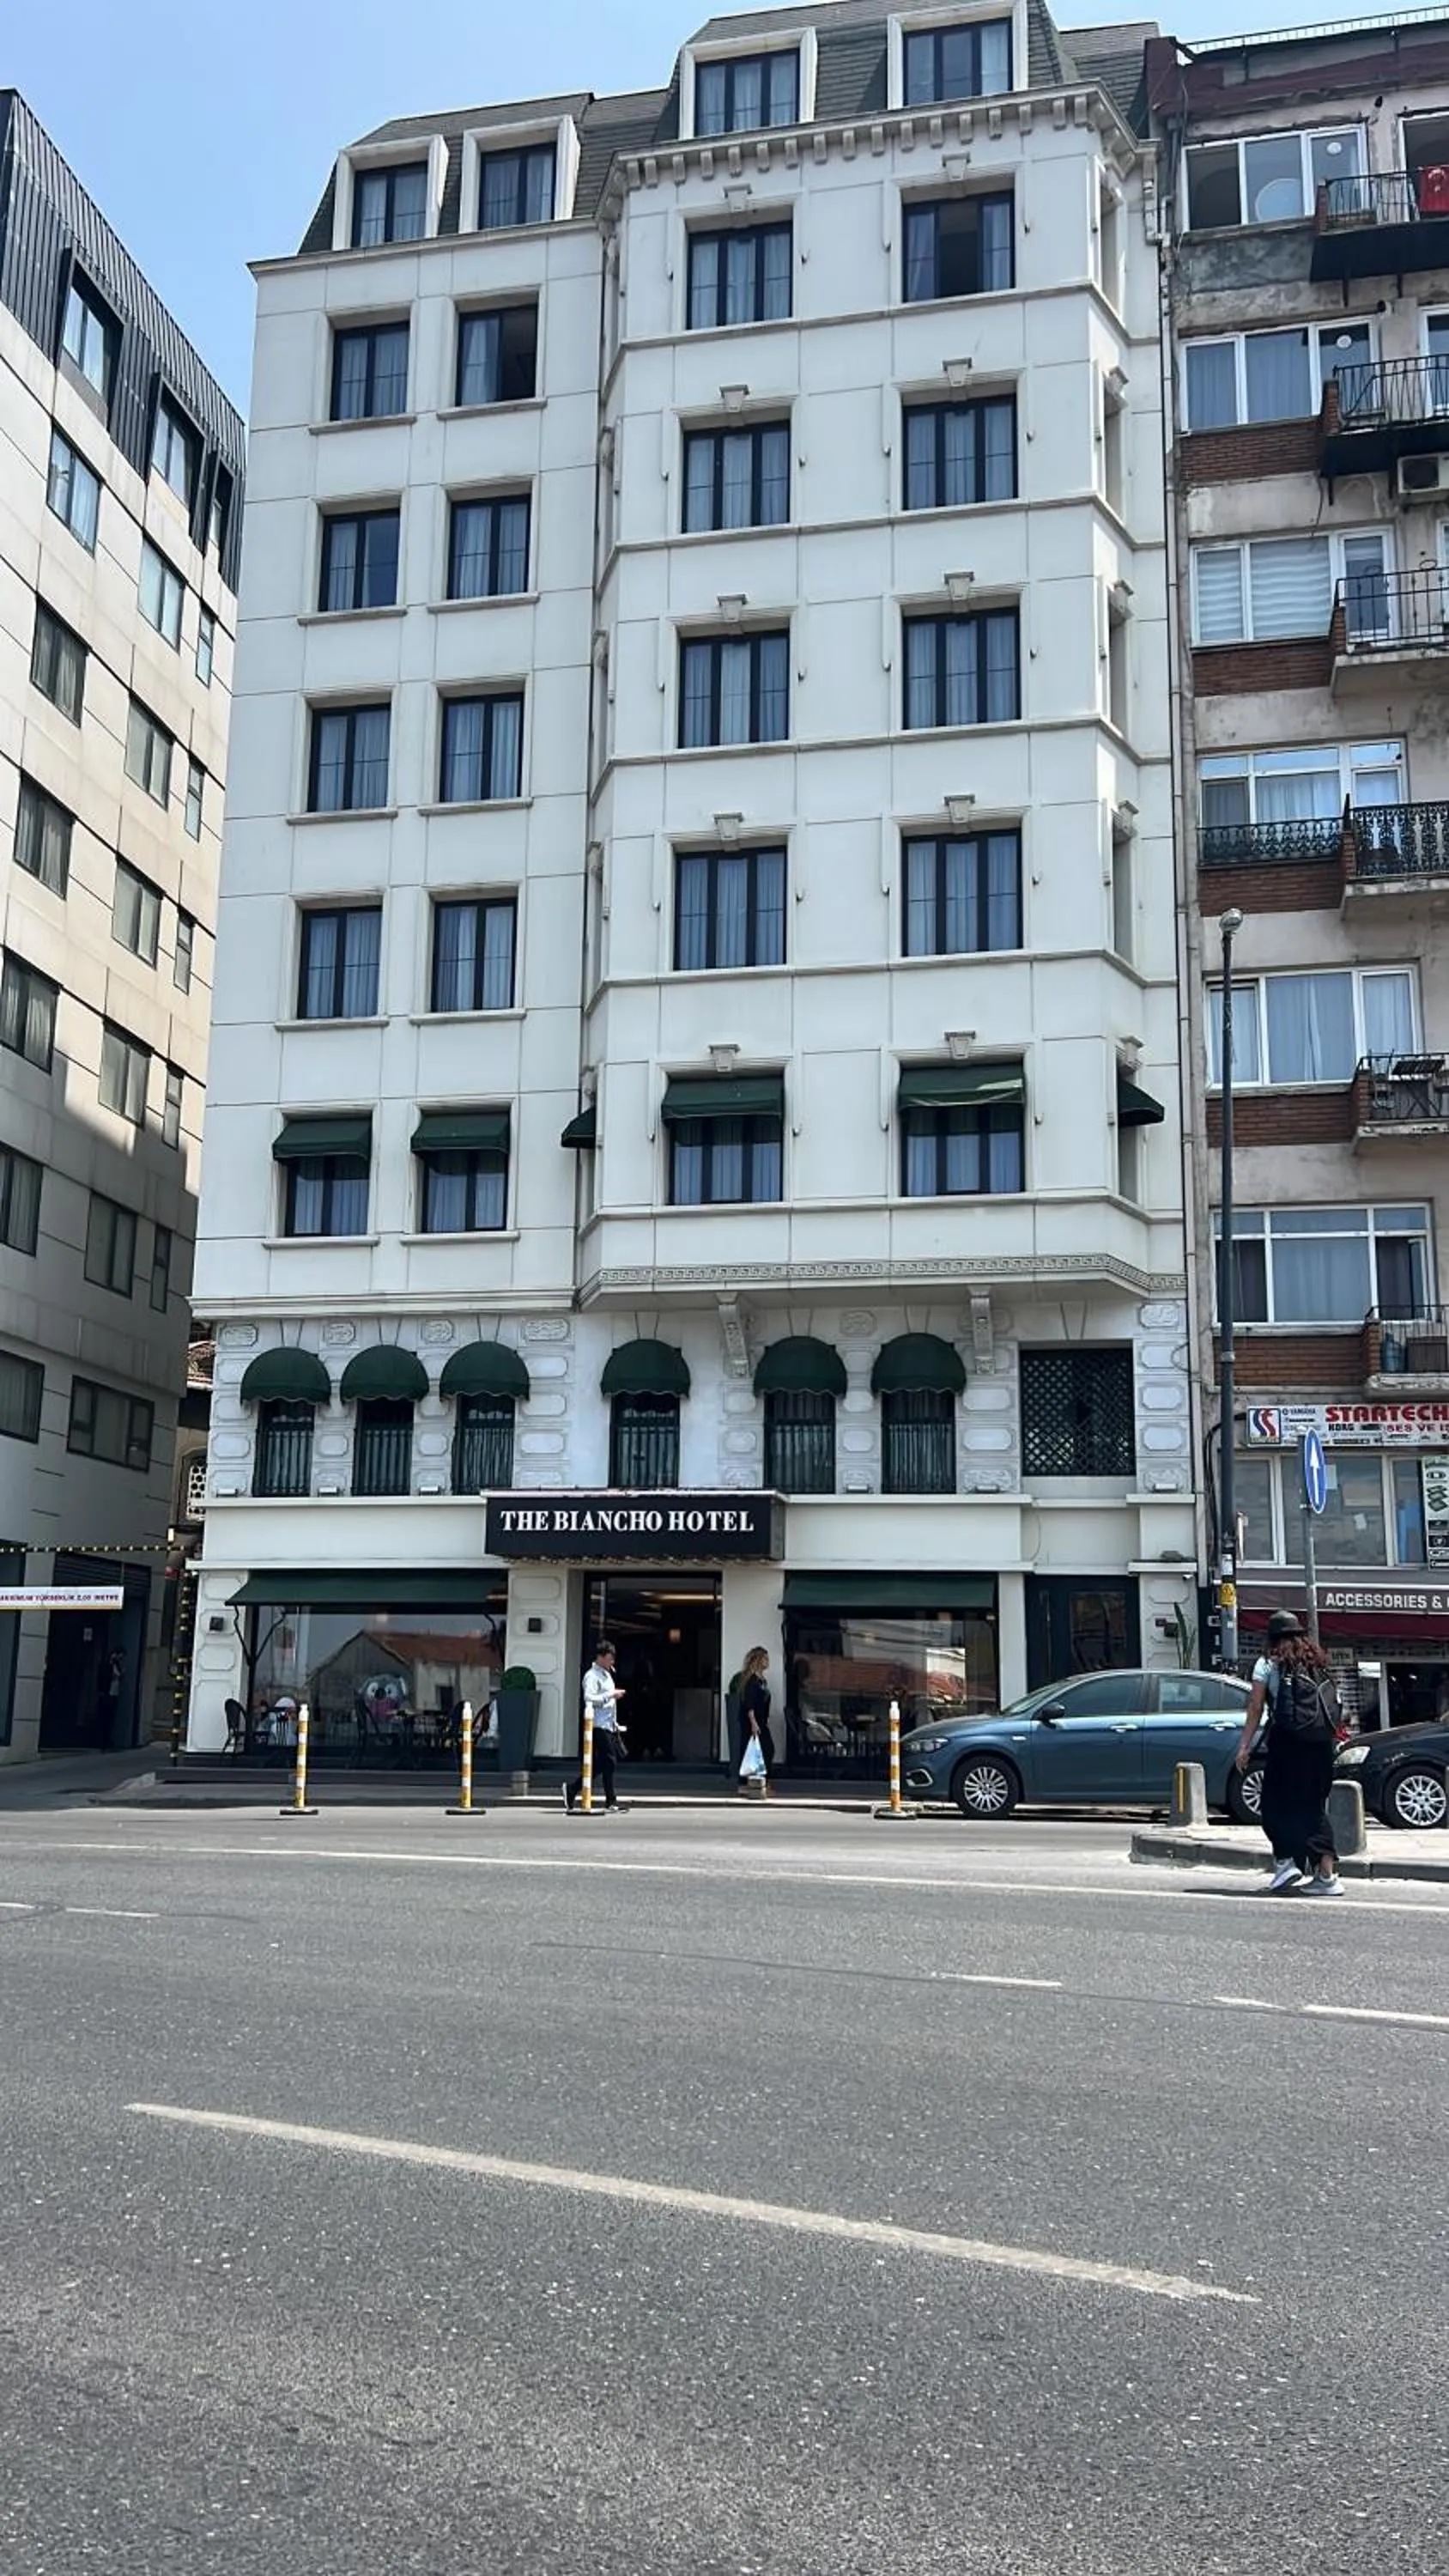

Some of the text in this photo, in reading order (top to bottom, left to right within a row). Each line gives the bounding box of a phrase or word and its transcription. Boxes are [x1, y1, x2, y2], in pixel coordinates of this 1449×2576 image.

[1325, 1406, 1449, 1422] STARTECH
[500, 1510, 755, 1532] THE BIANCHO HOTEL
[1325, 1593, 1427, 1608] ACCESSORIES
[1432, 1595, 1442, 1608] &
